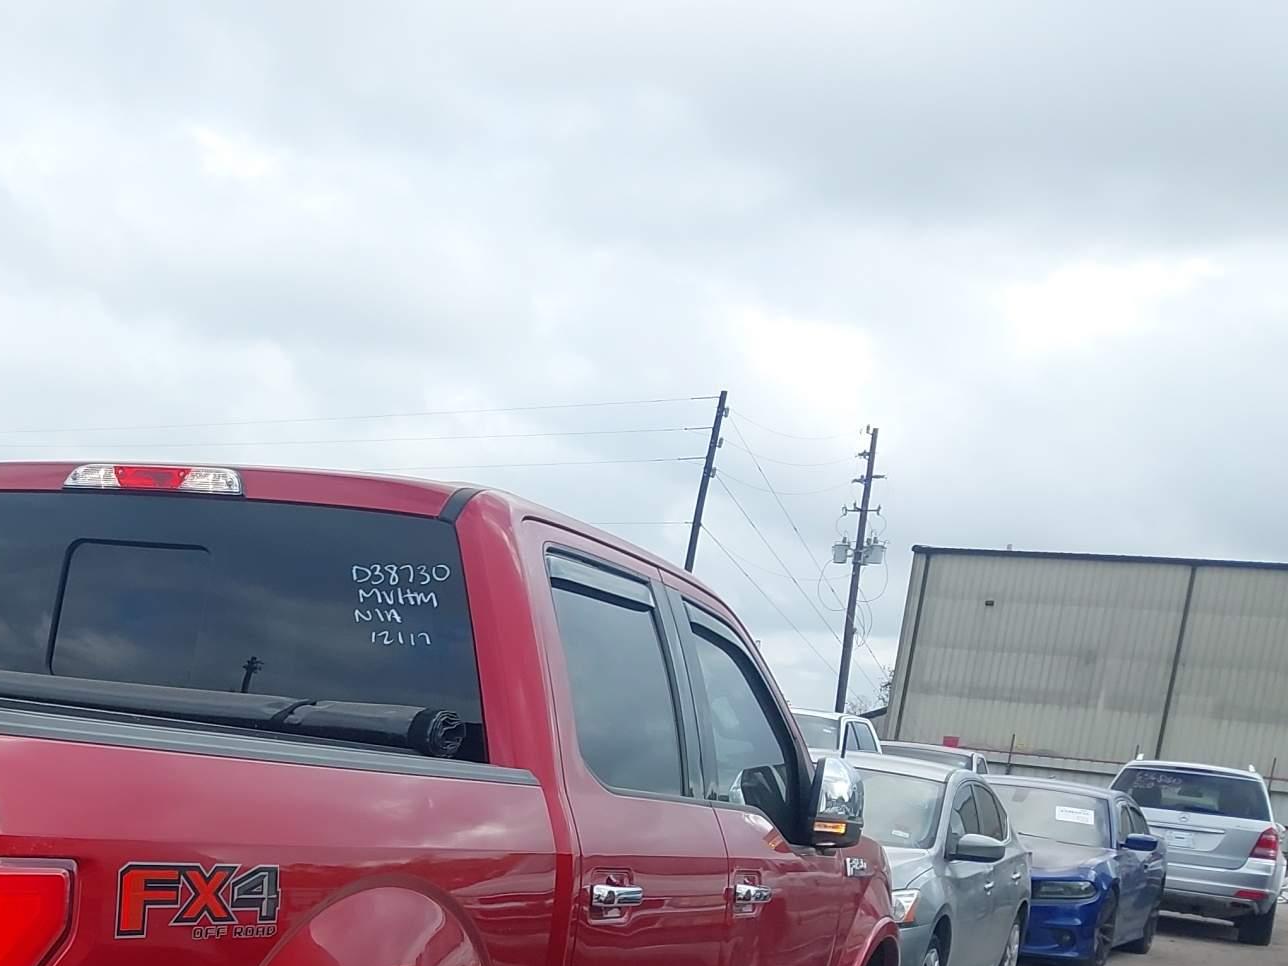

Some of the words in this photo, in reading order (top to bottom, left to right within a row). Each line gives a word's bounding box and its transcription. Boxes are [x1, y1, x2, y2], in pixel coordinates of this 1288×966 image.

[351, 563, 451, 585] D38730
[114, 861, 282, 940] FX4
[191, 924, 228, 940] OFF
[231, 923, 278, 940] ROAD
